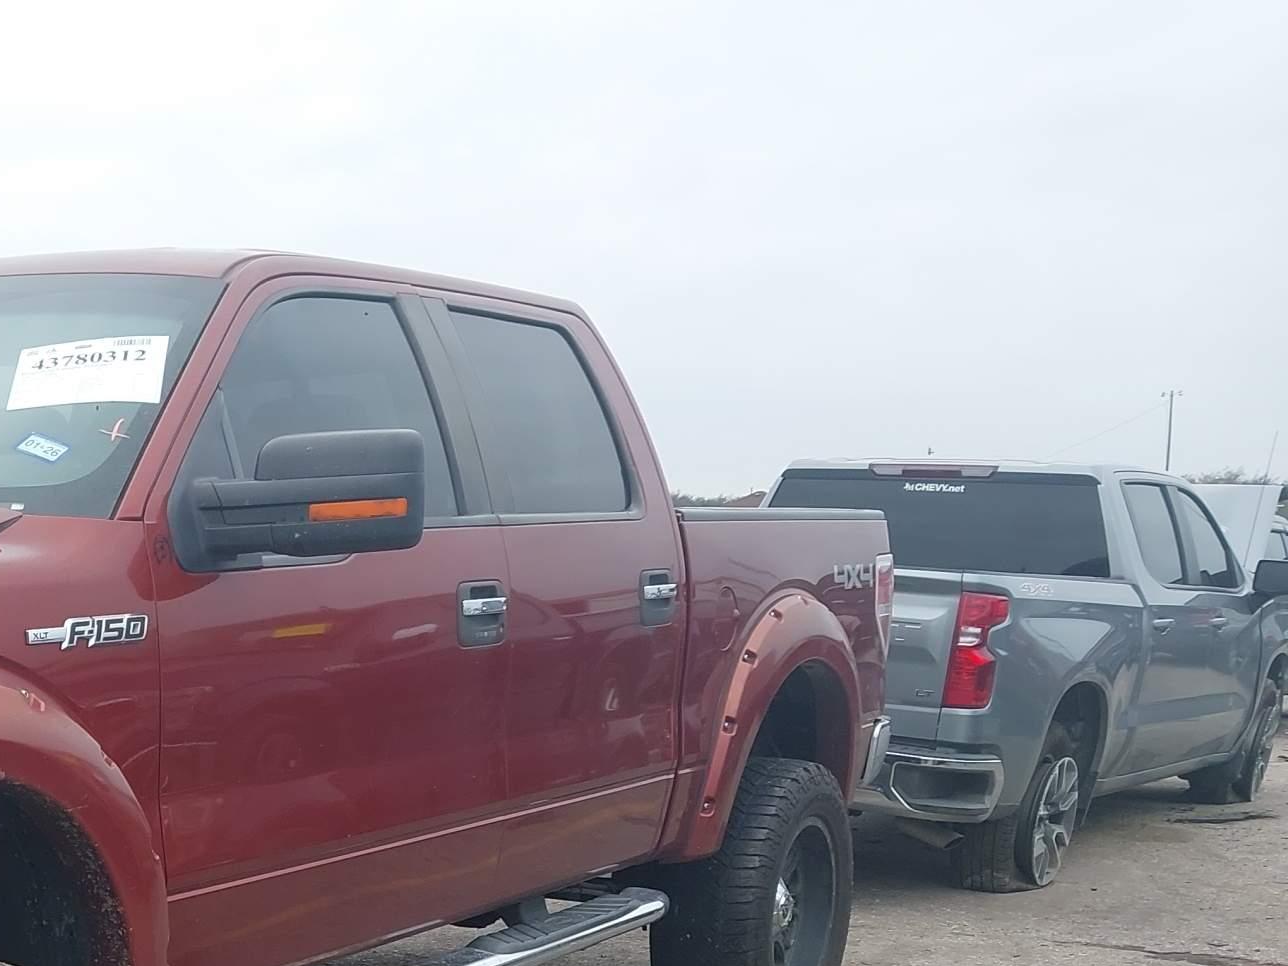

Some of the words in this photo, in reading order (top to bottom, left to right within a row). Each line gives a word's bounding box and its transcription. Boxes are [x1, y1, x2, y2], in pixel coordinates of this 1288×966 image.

[31, 349, 147, 370] 43780312
[32, 631, 49, 641] XLT
[62, 614, 148, 649] F-150
